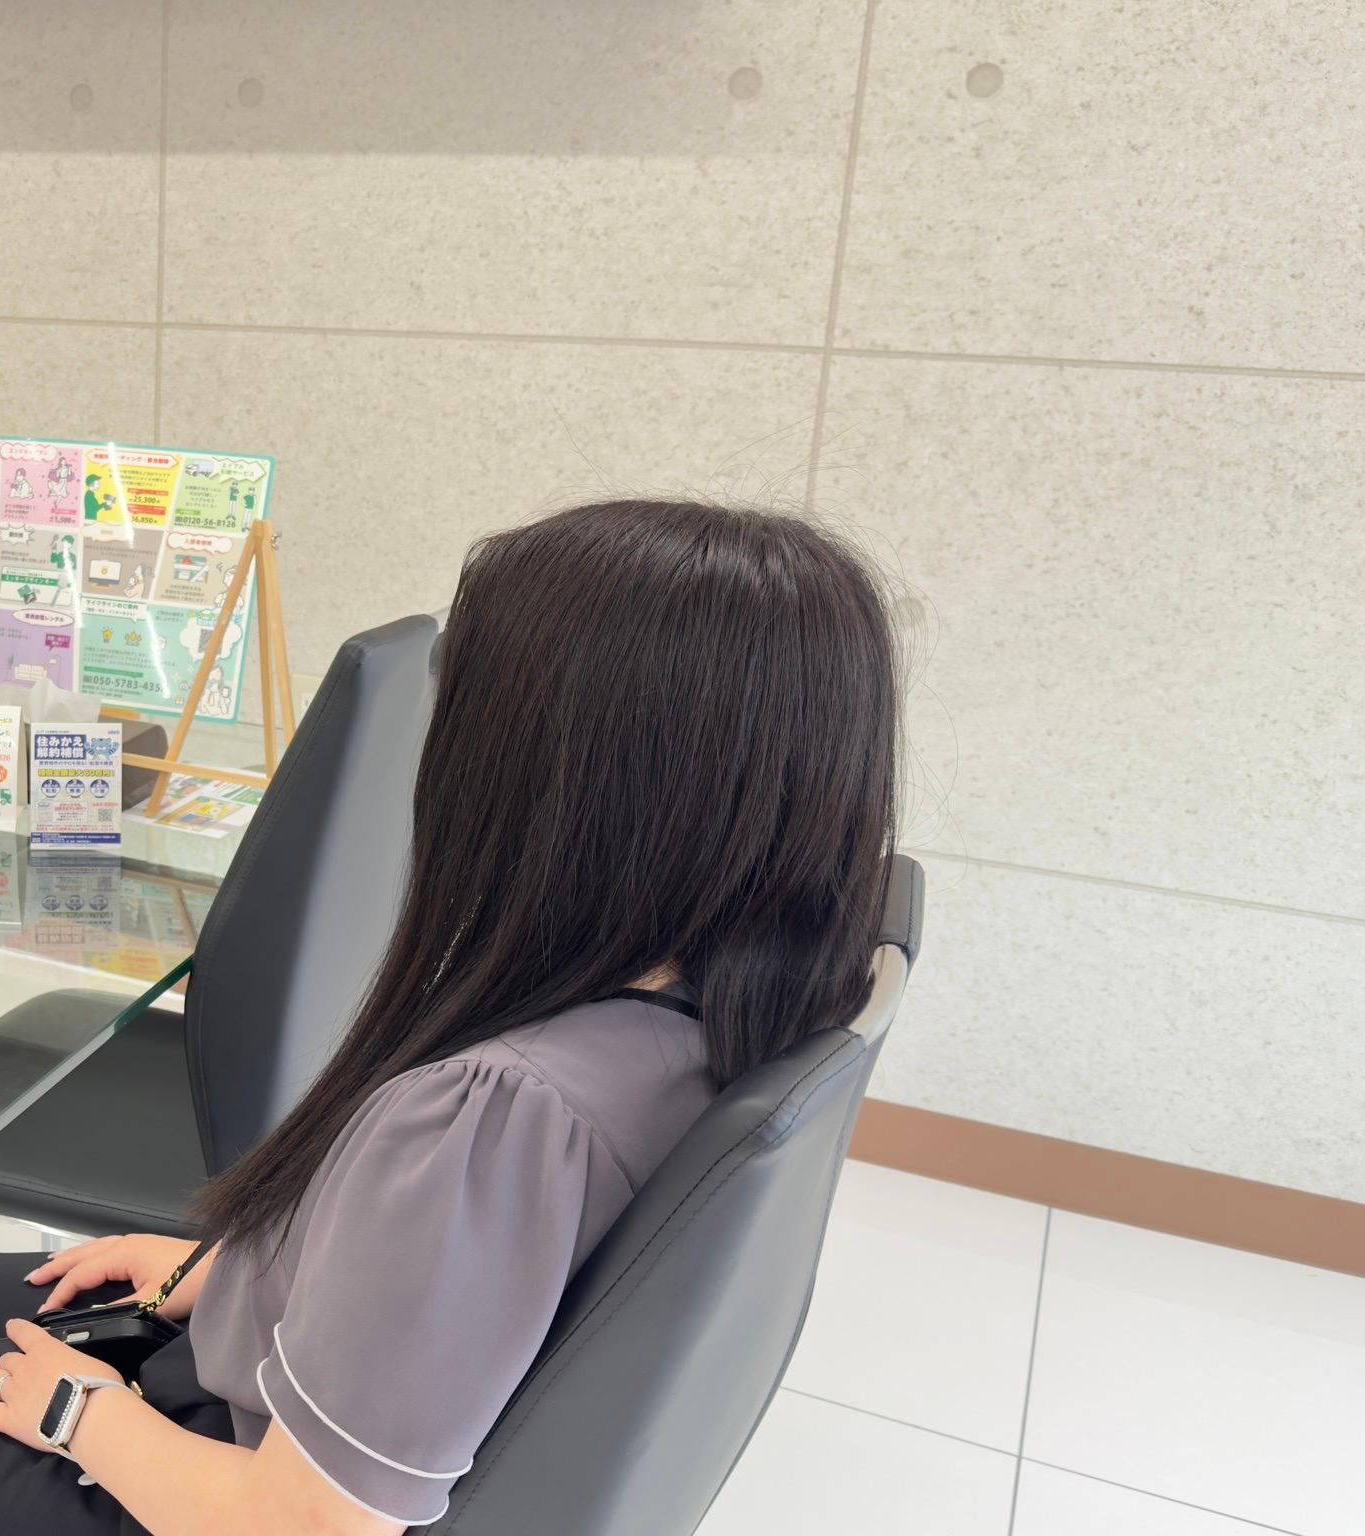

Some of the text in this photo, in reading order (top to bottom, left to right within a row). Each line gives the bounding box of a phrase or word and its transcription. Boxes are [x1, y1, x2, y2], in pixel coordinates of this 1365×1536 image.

[93, 675, 164, 693] 050-5783-435
[37, 736, 84, 748] 住みかえ
